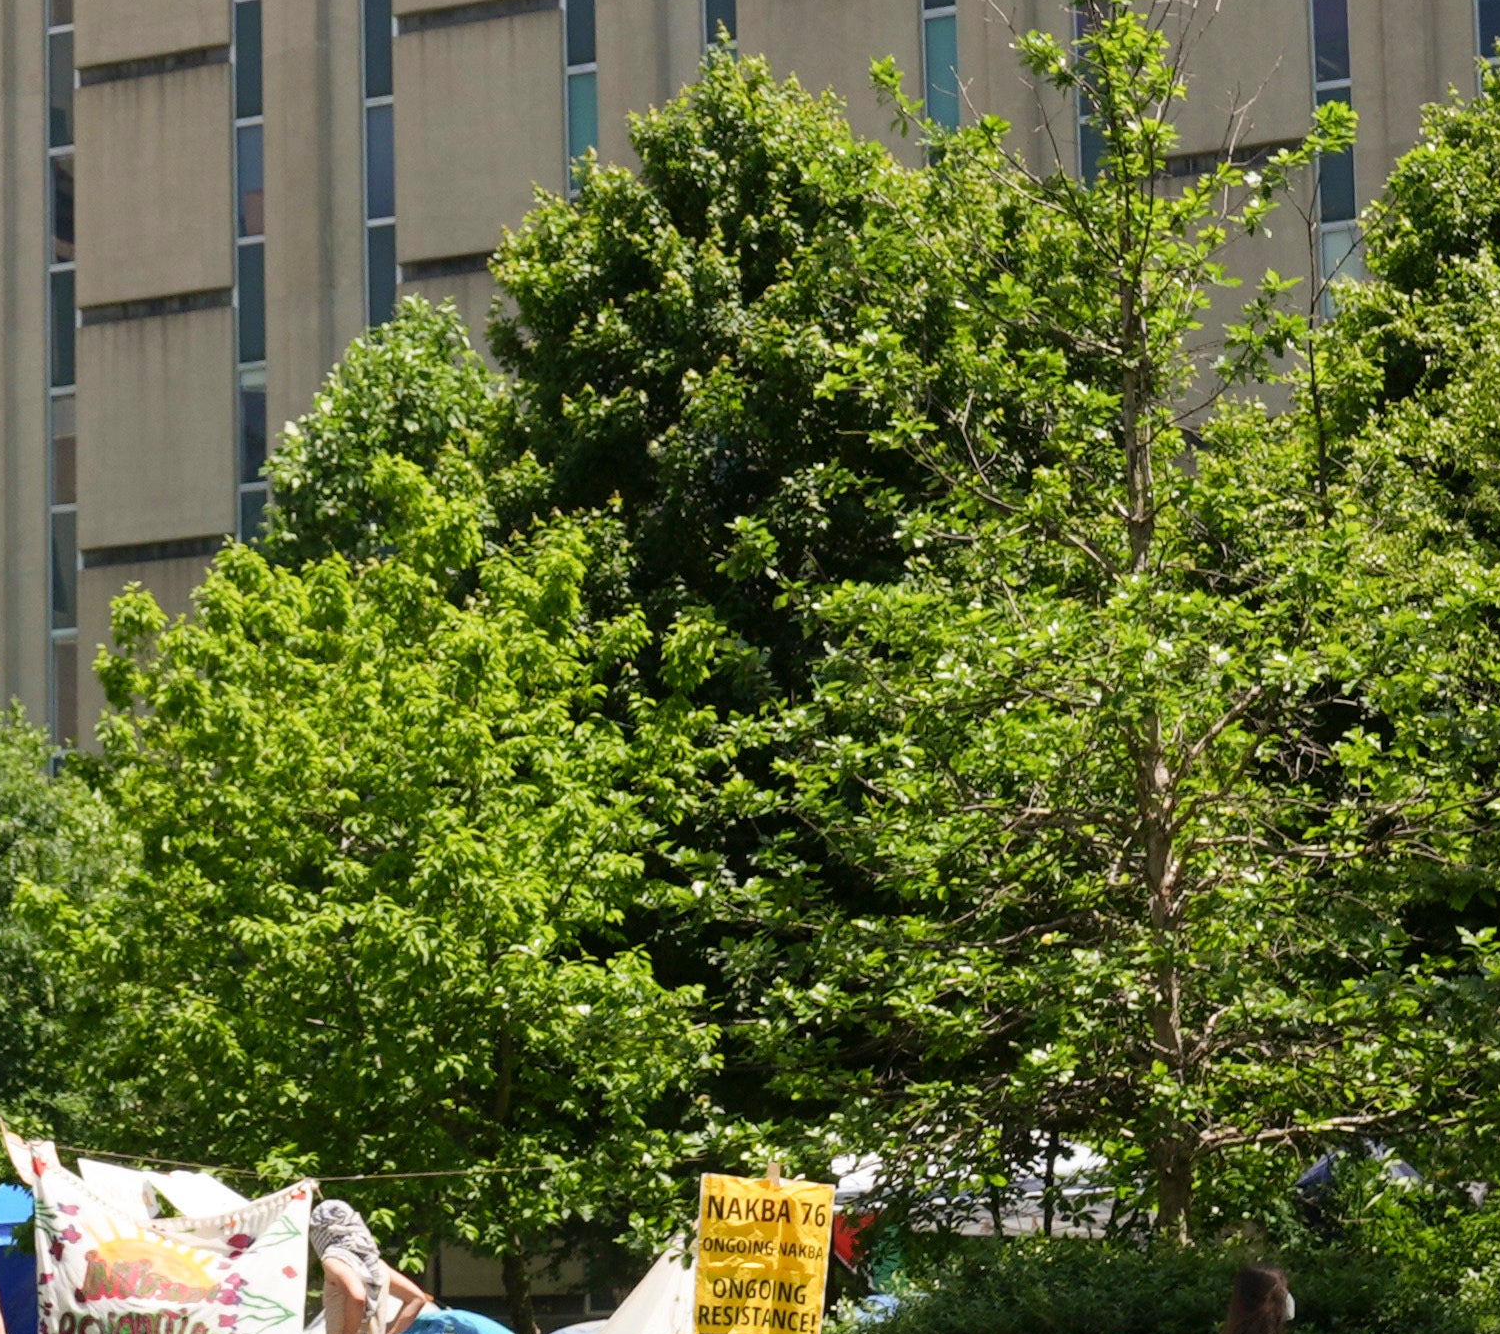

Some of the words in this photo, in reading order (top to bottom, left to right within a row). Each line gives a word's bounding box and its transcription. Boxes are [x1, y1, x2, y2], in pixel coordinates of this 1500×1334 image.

[707, 1195, 790, 1224] NAKBA
[801, 1203, 826, 1227] 76
[702, 1236, 774, 1256] ONGOING
[779, 1242, 823, 1261] NAKBA
[713, 1278, 806, 1305] ONGOING
